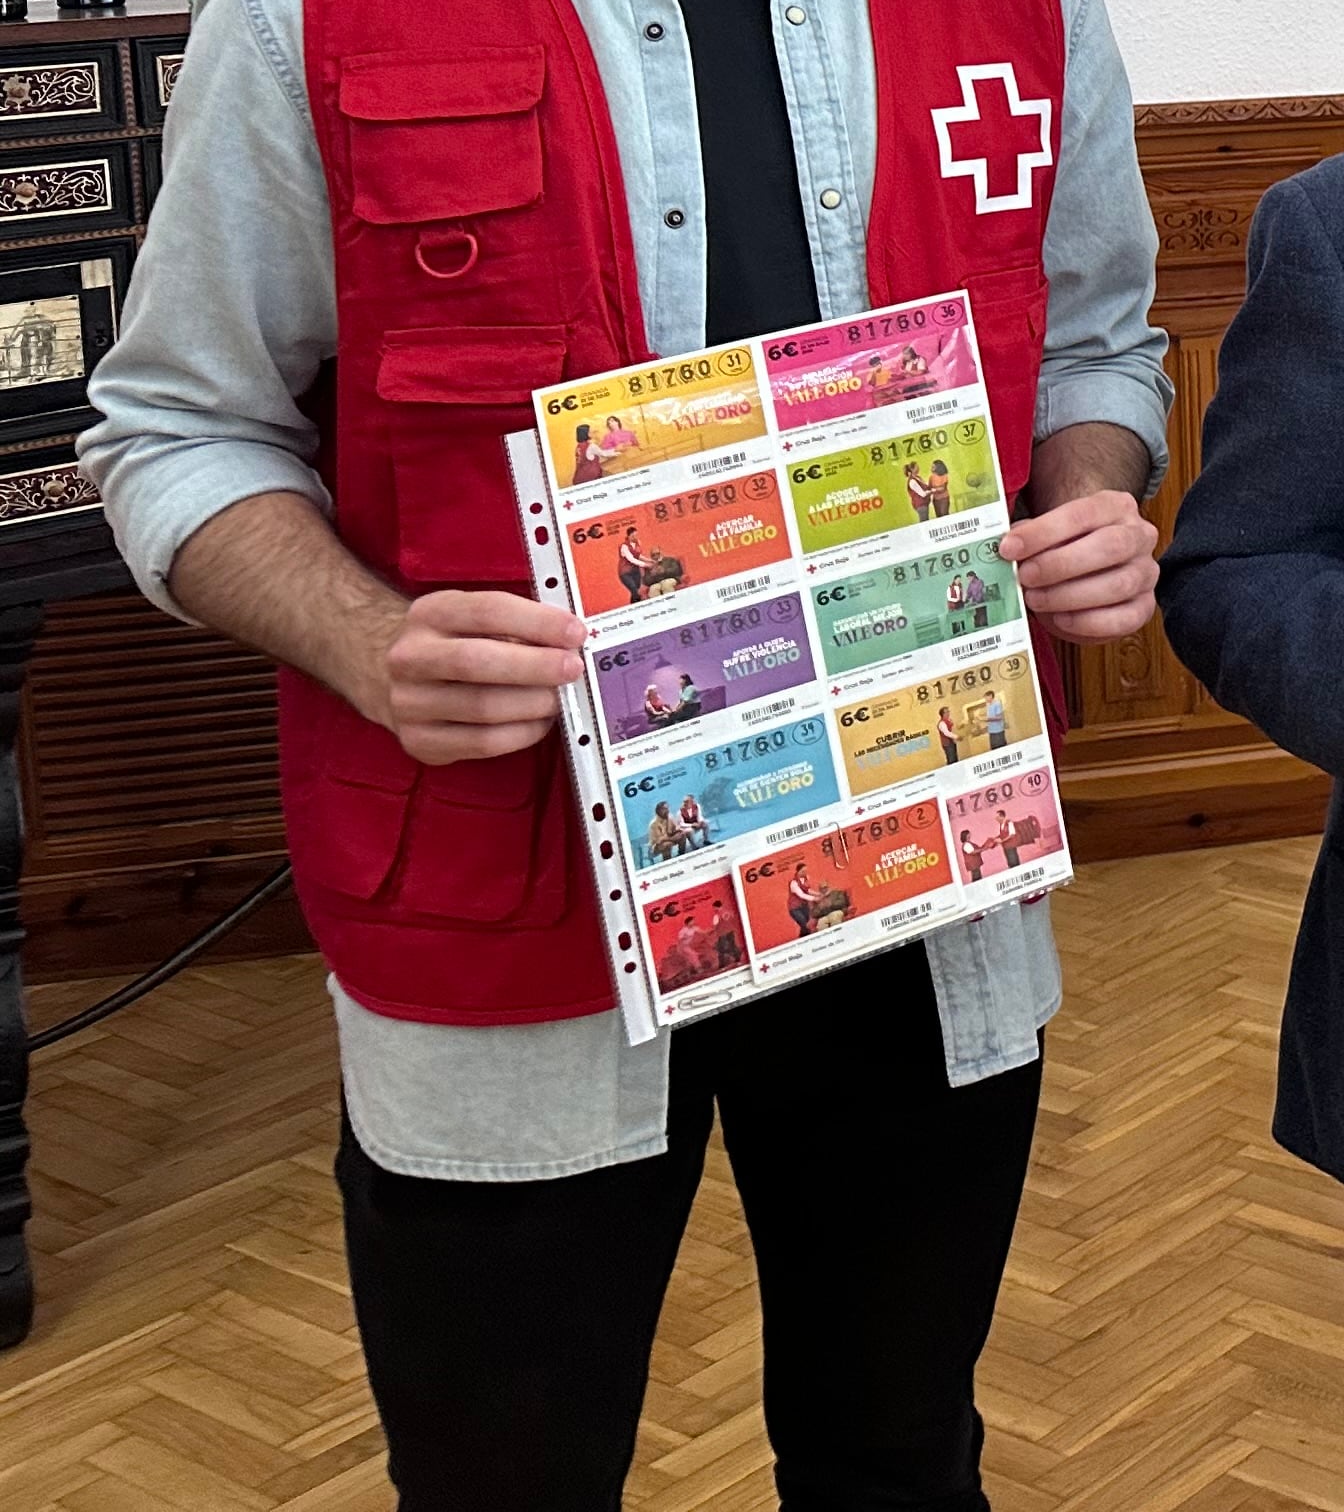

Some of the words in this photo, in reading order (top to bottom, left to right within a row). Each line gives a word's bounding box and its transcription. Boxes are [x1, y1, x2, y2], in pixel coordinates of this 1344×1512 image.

[941, 306, 955, 318] 36
[848, 311, 926, 341] 81760
[727, 353, 741, 368] 31
[768, 341, 798, 361] 6€
[628, 360, 711, 393] 81760
[824, 377, 862, 397] ORO
[547, 395, 579, 415] 6€
[963, 424, 975, 437] 37
[870, 430, 948, 461] 81760
[792, 464, 822, 483] 6€
[752, 478, 768, 491] 32
[654, 485, 736, 519] 81760
[847, 497, 884, 516] ORO
[573, 523, 604, 544] 6€
[740, 525, 777, 546] ORO
[893, 549, 970, 581] 81760
[776, 600, 792, 613] 33
[817, 587, 847, 606] 6€
[680, 608, 761, 645] 81760
[873, 616, 908, 636] ORO
[598, 651, 630, 672] 6€
[763, 648, 800, 669] ORO
[1006, 659, 1019, 671] 39
[916, 666, 991, 701] 81760
[840, 707, 870, 727] 6€
[705, 731, 785, 769] 81760
[624, 776, 655, 798] 6€
[778, 773, 814, 794] ORO
[949, 783, 1013, 816] 1760
[918, 808, 925, 820] 2
[746, 862, 776, 883] 6€
[904, 852, 939, 874] ORO
[650, 902, 680, 924] 6€
